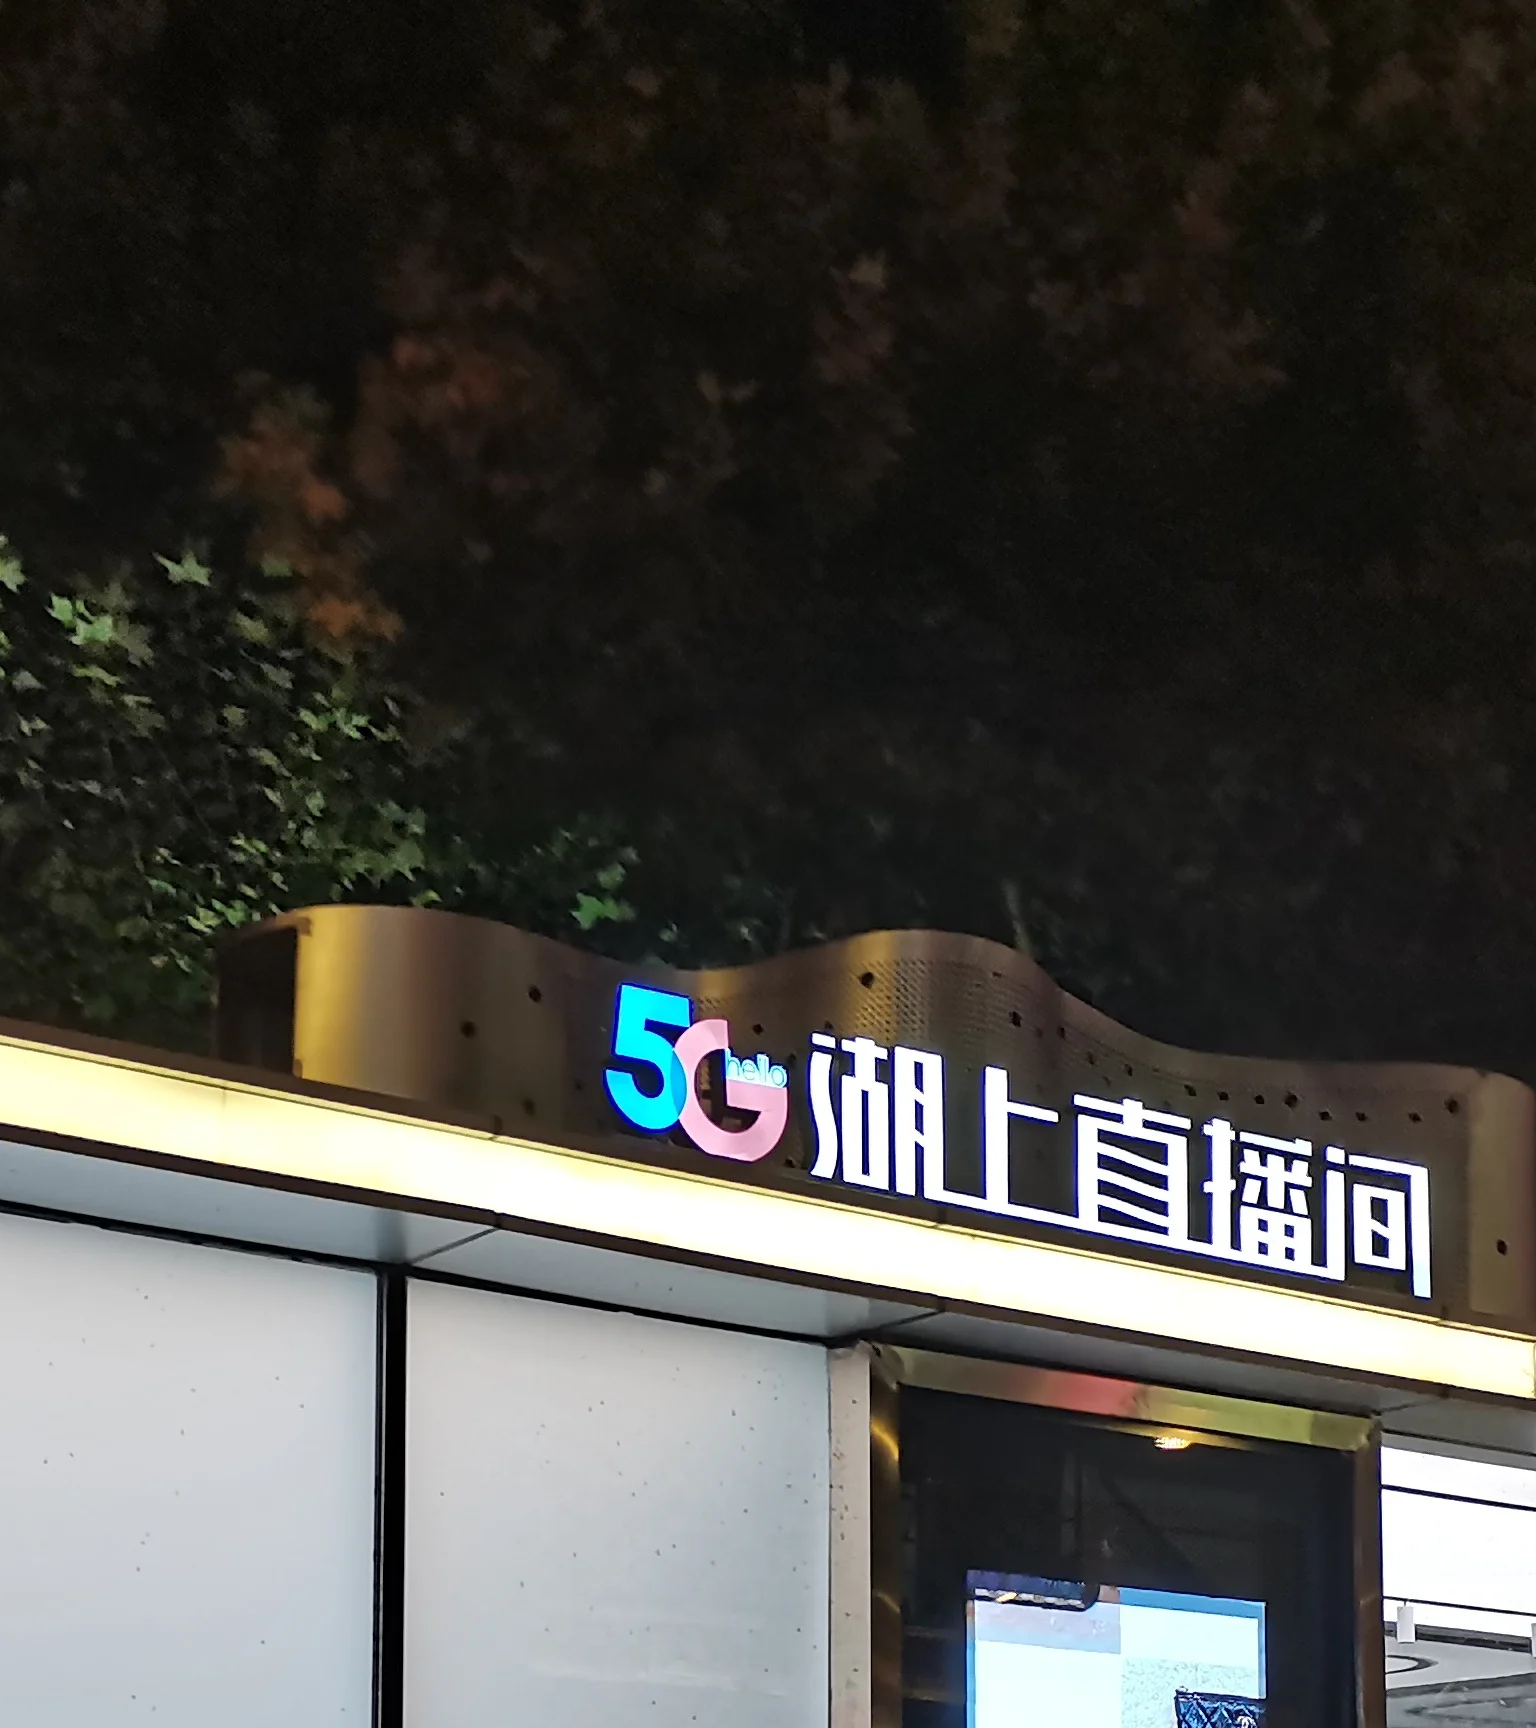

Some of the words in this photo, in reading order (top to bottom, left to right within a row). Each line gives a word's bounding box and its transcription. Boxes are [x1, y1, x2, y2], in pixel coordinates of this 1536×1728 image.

[603, 982, 789, 1162] 5G
[809, 1032, 1432, 1299] 湖上直播间
[725, 1048, 788, 1089] hello
